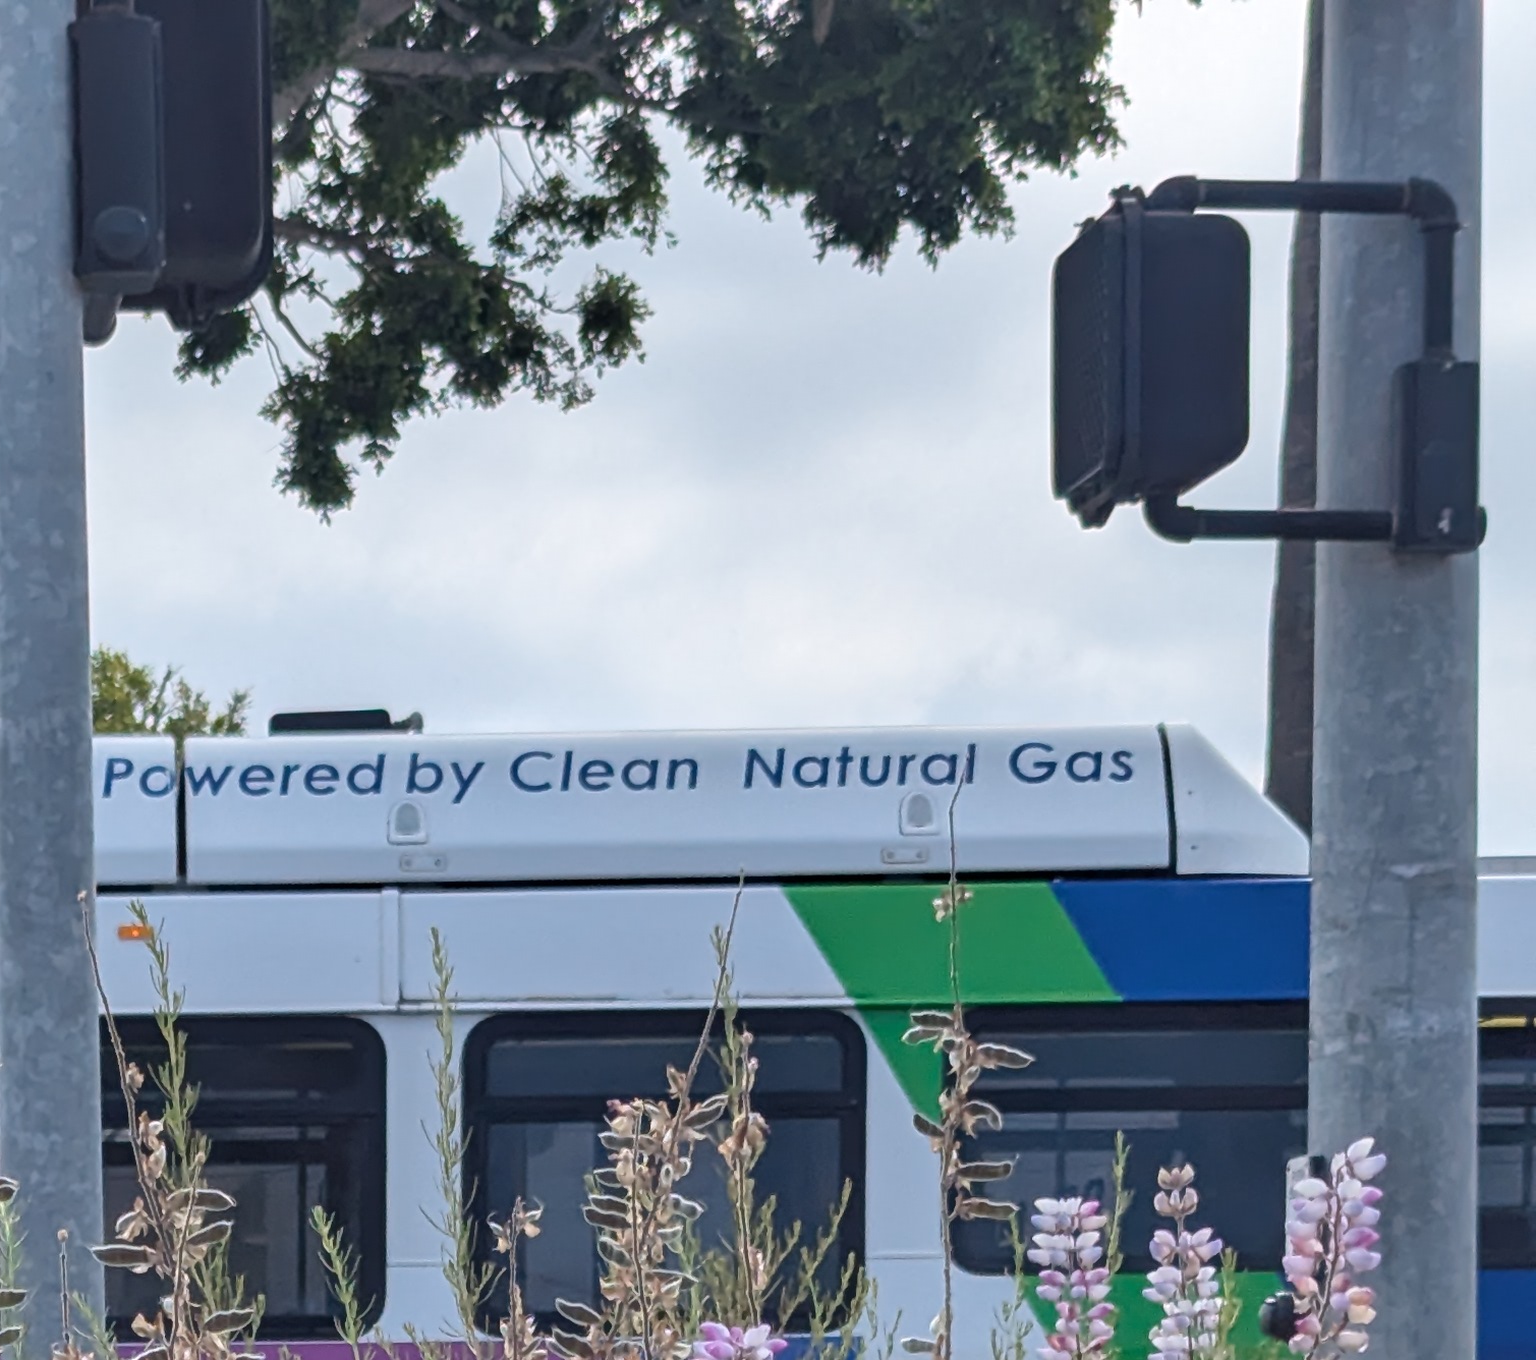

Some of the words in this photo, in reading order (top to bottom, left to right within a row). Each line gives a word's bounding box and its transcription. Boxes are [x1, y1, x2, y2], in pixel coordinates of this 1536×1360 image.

[102, 752, 387, 799] Powered
[406, 751, 485, 804] by
[509, 749, 700, 793] Clean
[743, 743, 977, 789] Natural
[1007, 741, 1135, 784] Gas
